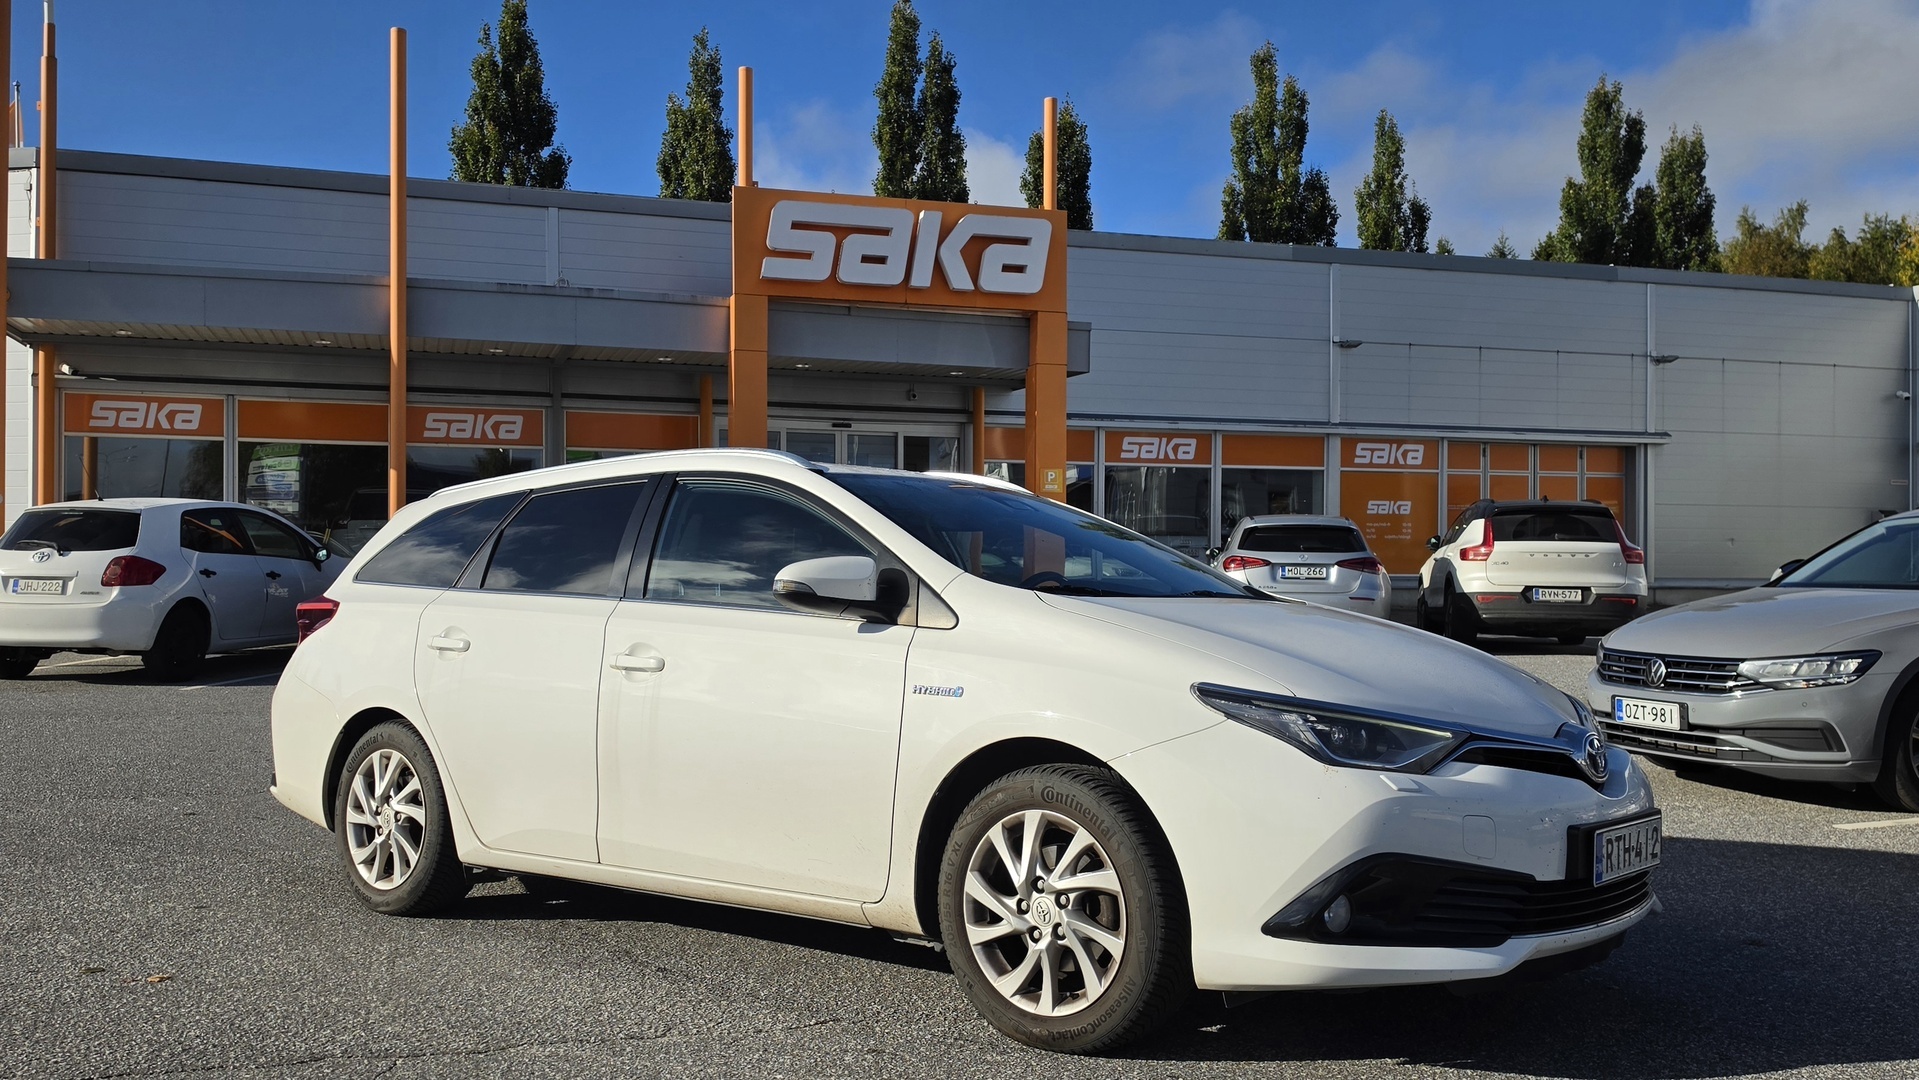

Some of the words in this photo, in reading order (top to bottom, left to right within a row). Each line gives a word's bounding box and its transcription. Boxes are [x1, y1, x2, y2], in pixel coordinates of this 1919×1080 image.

[1047, 471, 1056, 483] P
[1287, 567, 1324, 576] MOL-266
[20, 581, 60, 592] JHJ-222
[1541, 588, 1579, 599] RVN-577
[1625, 703, 1673, 724] OZT-981
[346, 732, 380, 773] Continental
[1041, 786, 1117, 842] Continental
[1605, 825, 1660, 874] RTH-412
